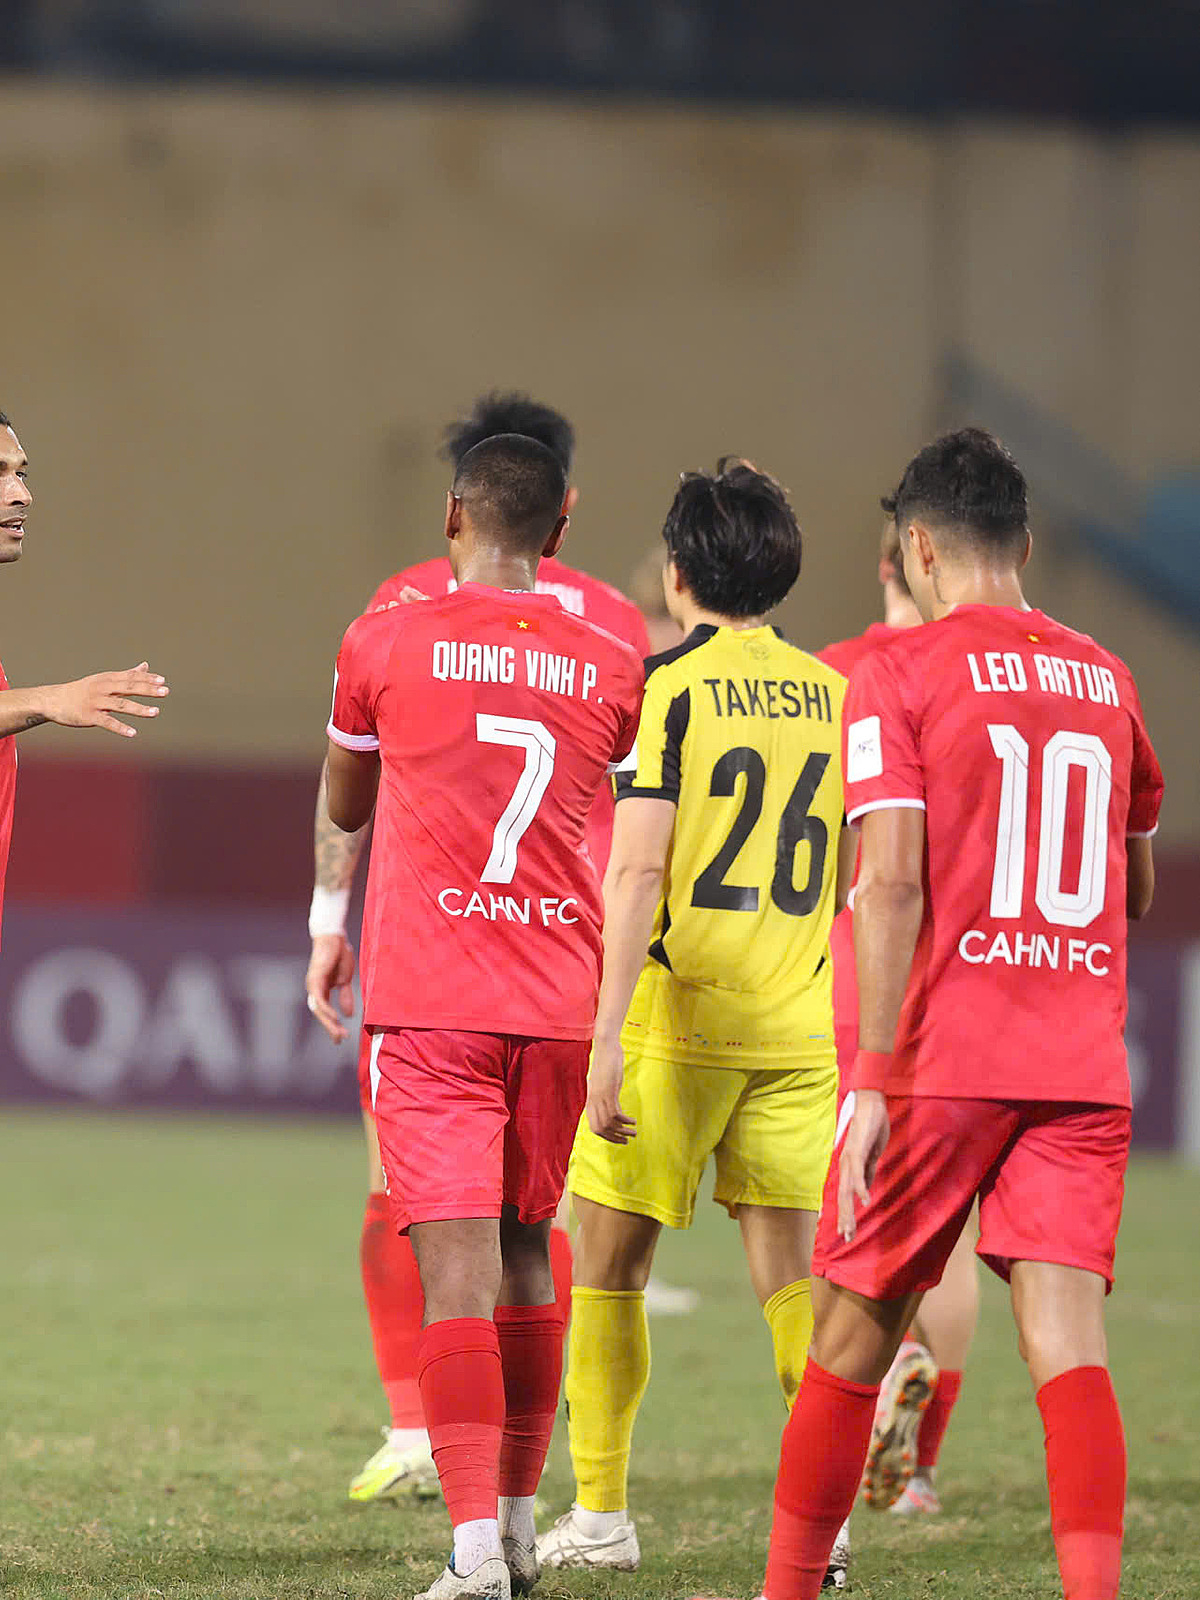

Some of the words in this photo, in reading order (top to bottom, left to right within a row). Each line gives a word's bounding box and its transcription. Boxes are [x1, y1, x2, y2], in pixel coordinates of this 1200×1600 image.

[432, 640, 515, 684] QUANG
[525, 649, 577, 697] VINH
[581, 662, 605, 704] P.
[703, 678, 832, 722] TAKESHI
[966, 651, 1028, 693] LEO
[1033, 653, 1120, 708] ARTUR
[476, 712, 557, 884] 7
[987, 725, 1112, 927] 10
[690, 746, 832, 917] 26
[437, 887, 531, 925] CAHN
[539, 897, 579, 927] FC
[958, 930, 1060, 969] CAHN
[1068, 937, 1112, 976] FC
